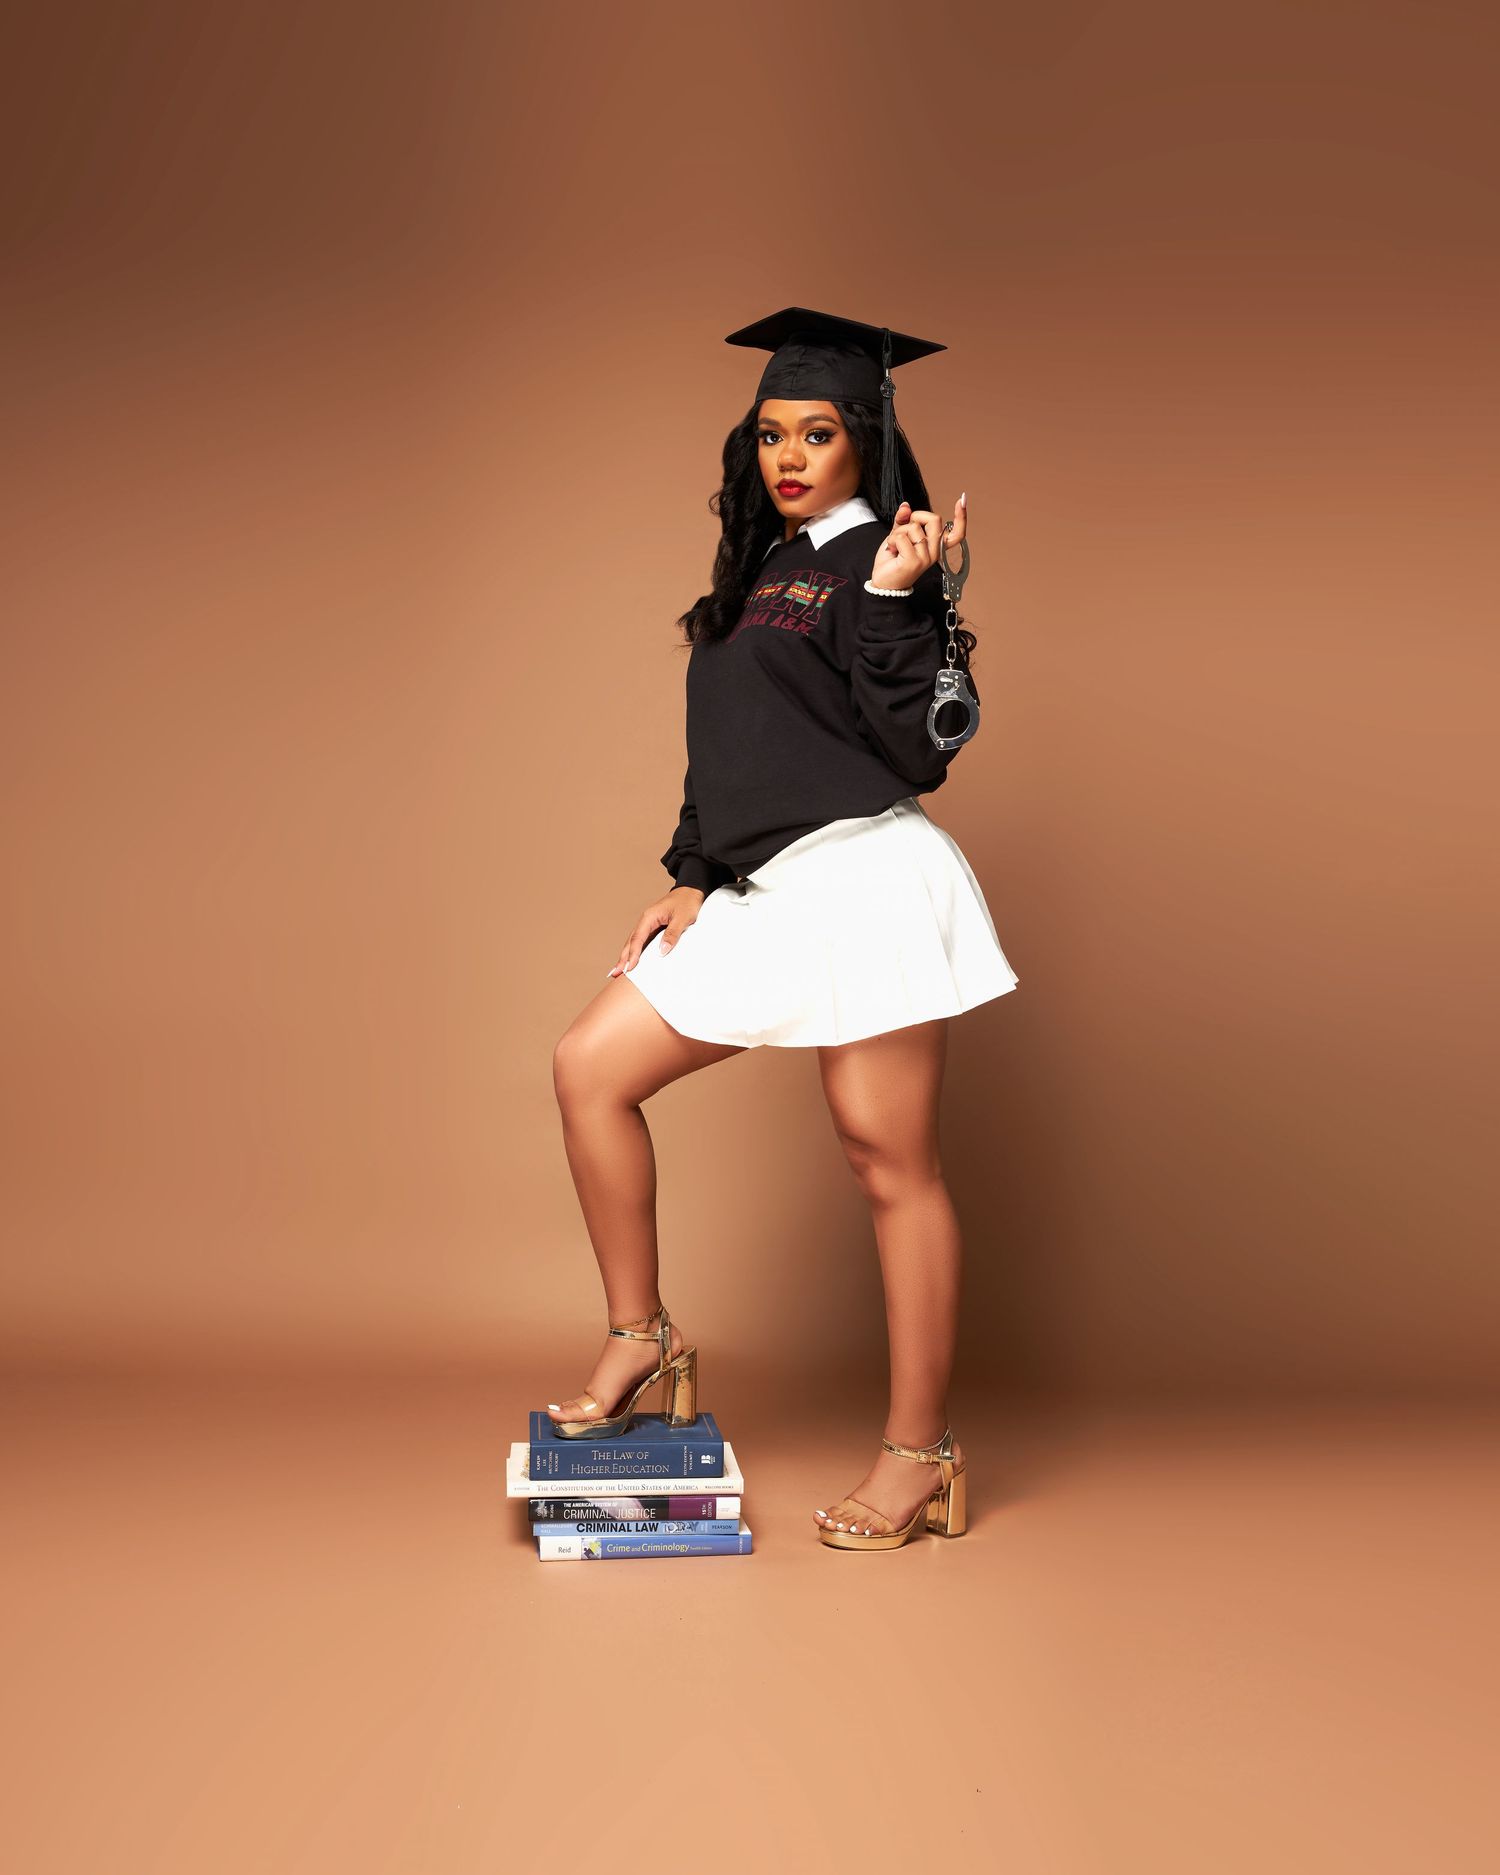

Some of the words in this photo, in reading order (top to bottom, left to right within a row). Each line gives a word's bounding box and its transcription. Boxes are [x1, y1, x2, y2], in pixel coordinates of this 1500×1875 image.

[592, 1450, 611, 1460] THE
[613, 1450, 635, 1460] LAW
[636, 1450, 649, 1460] OF
[571, 1464, 611, 1474] HIGHER
[611, 1464, 670, 1474] EDUCATION
[550, 1484, 594, 1492] CONSTITUTION
[563, 1509, 611, 1520] CRIMINAL
[615, 1508, 656, 1519] JUSTICE
[576, 1522, 632, 1533] CRIMINAL
[635, 1522, 659, 1532] LAW
[606, 1543, 631, 1553] Crime
[641, 1542, 690, 1553] Criminology
